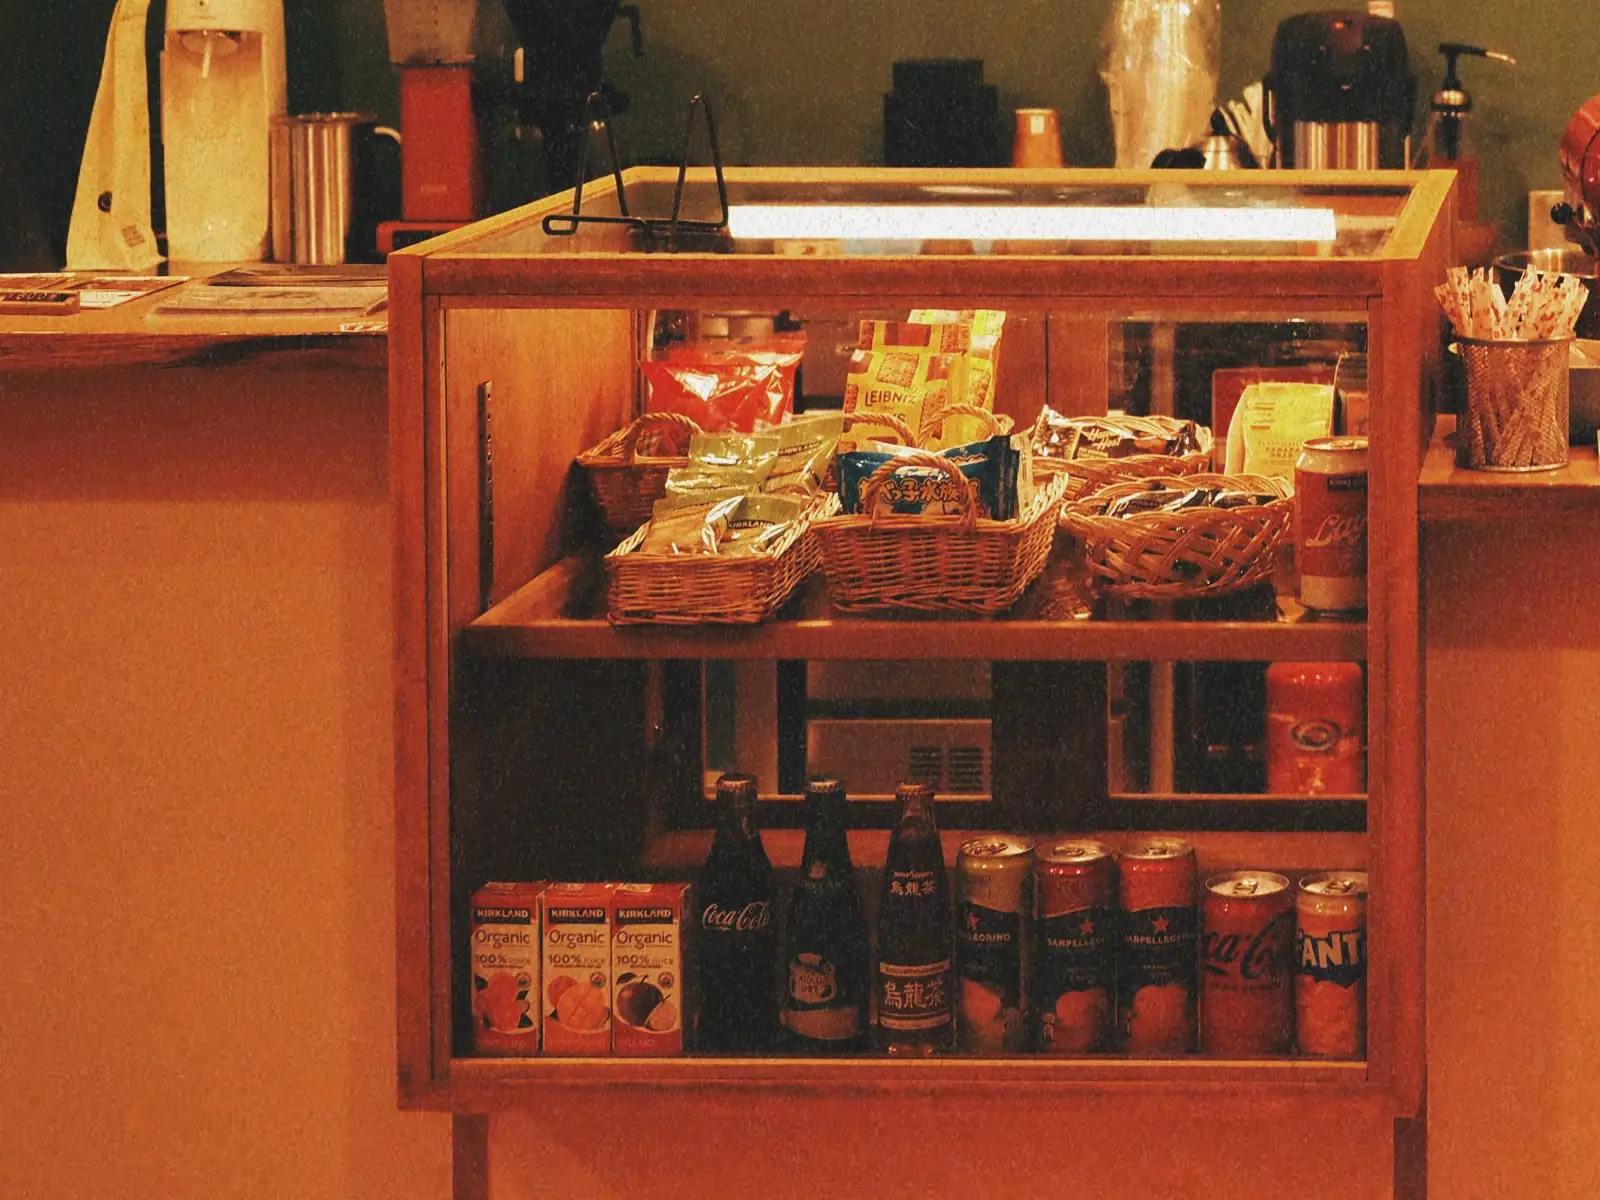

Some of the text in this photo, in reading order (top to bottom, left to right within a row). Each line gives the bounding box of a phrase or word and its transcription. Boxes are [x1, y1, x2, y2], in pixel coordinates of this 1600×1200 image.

[864, 390, 916, 407] LEIBNIZ
[477, 908, 528, 918] KIRKLAND
[551, 908, 604, 918] KIRKLAND
[619, 908, 672, 918] KIRKLAND
[475, 929, 531, 949] Organic
[549, 929, 605, 949] Organic
[617, 929, 673, 949] Organic
[1301, 932, 1361, 969] ANT
[475, 954, 506, 964] 100%
[549, 954, 580, 964] 100%
[617, 954, 648, 964] 100%
[884, 977, 946, 1009] 烏龍茶
